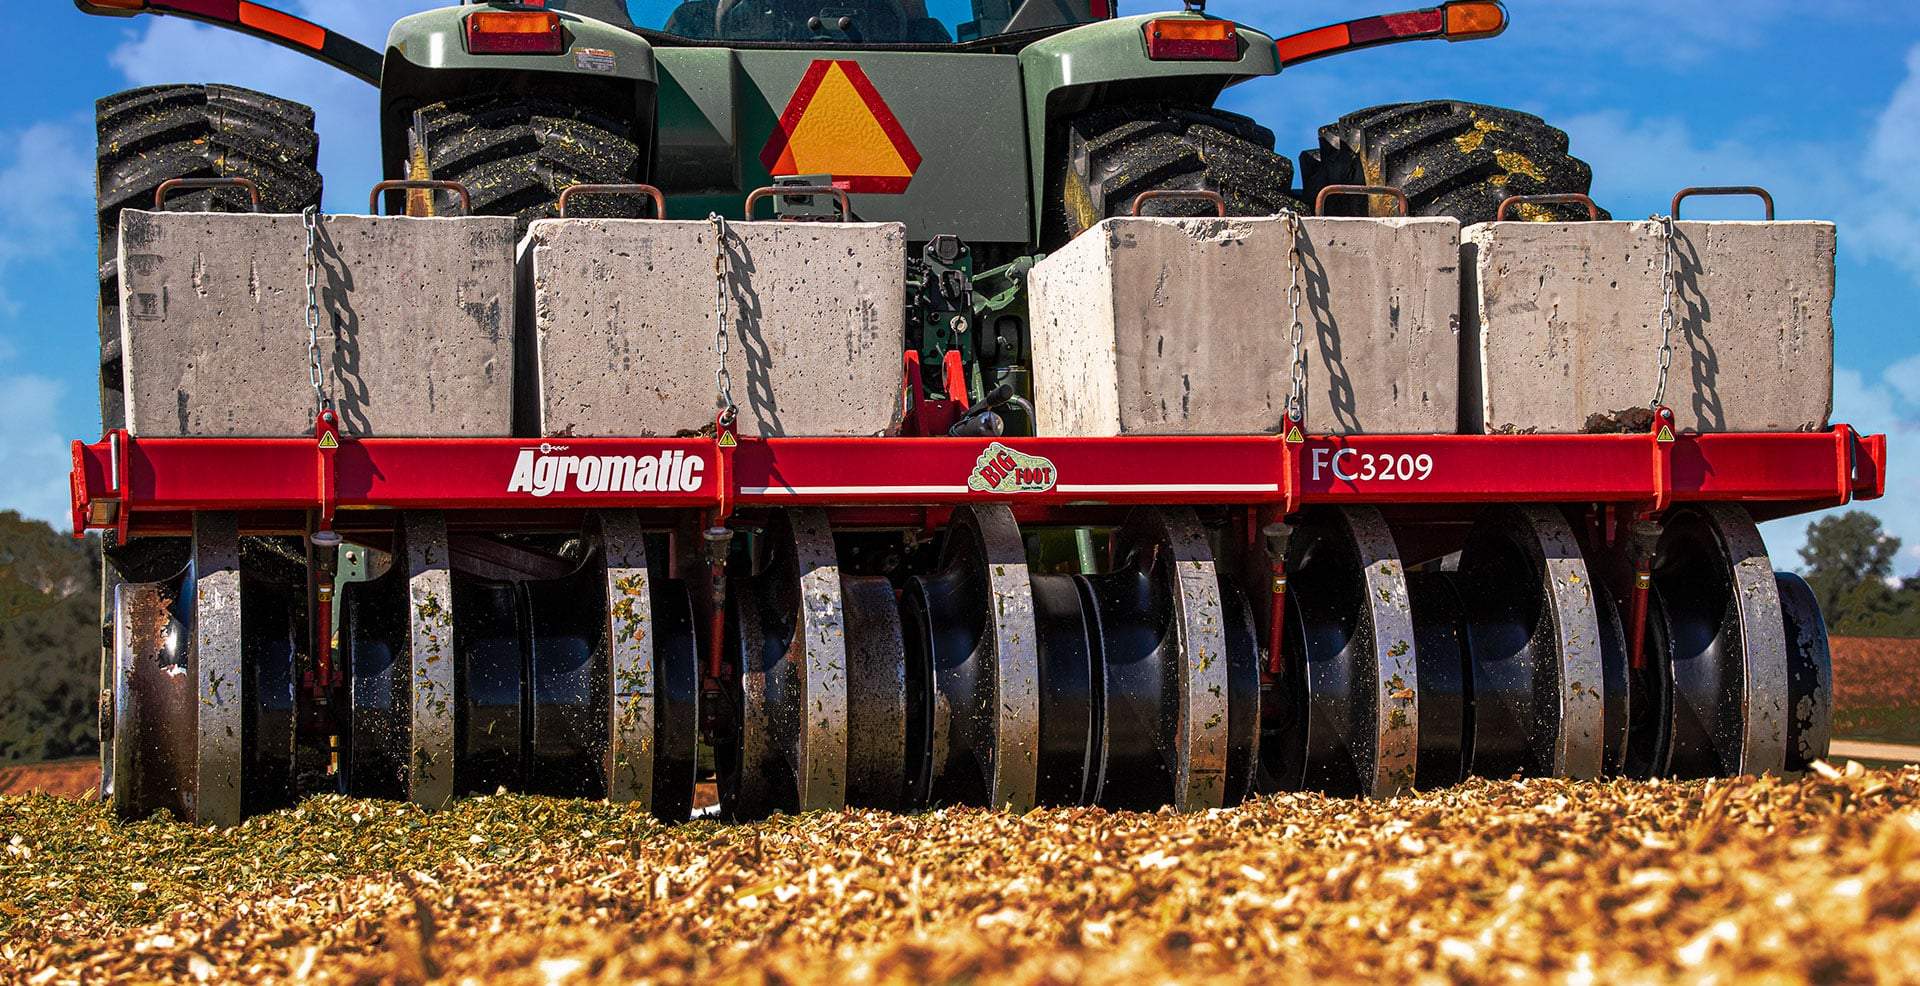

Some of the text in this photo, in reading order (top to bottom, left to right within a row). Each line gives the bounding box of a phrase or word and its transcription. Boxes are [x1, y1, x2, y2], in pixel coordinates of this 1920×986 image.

[507, 450, 704, 497] Agromatic
[980, 450, 1051, 489] BIG FOOT
[1312, 448, 1433, 480] FC3209
